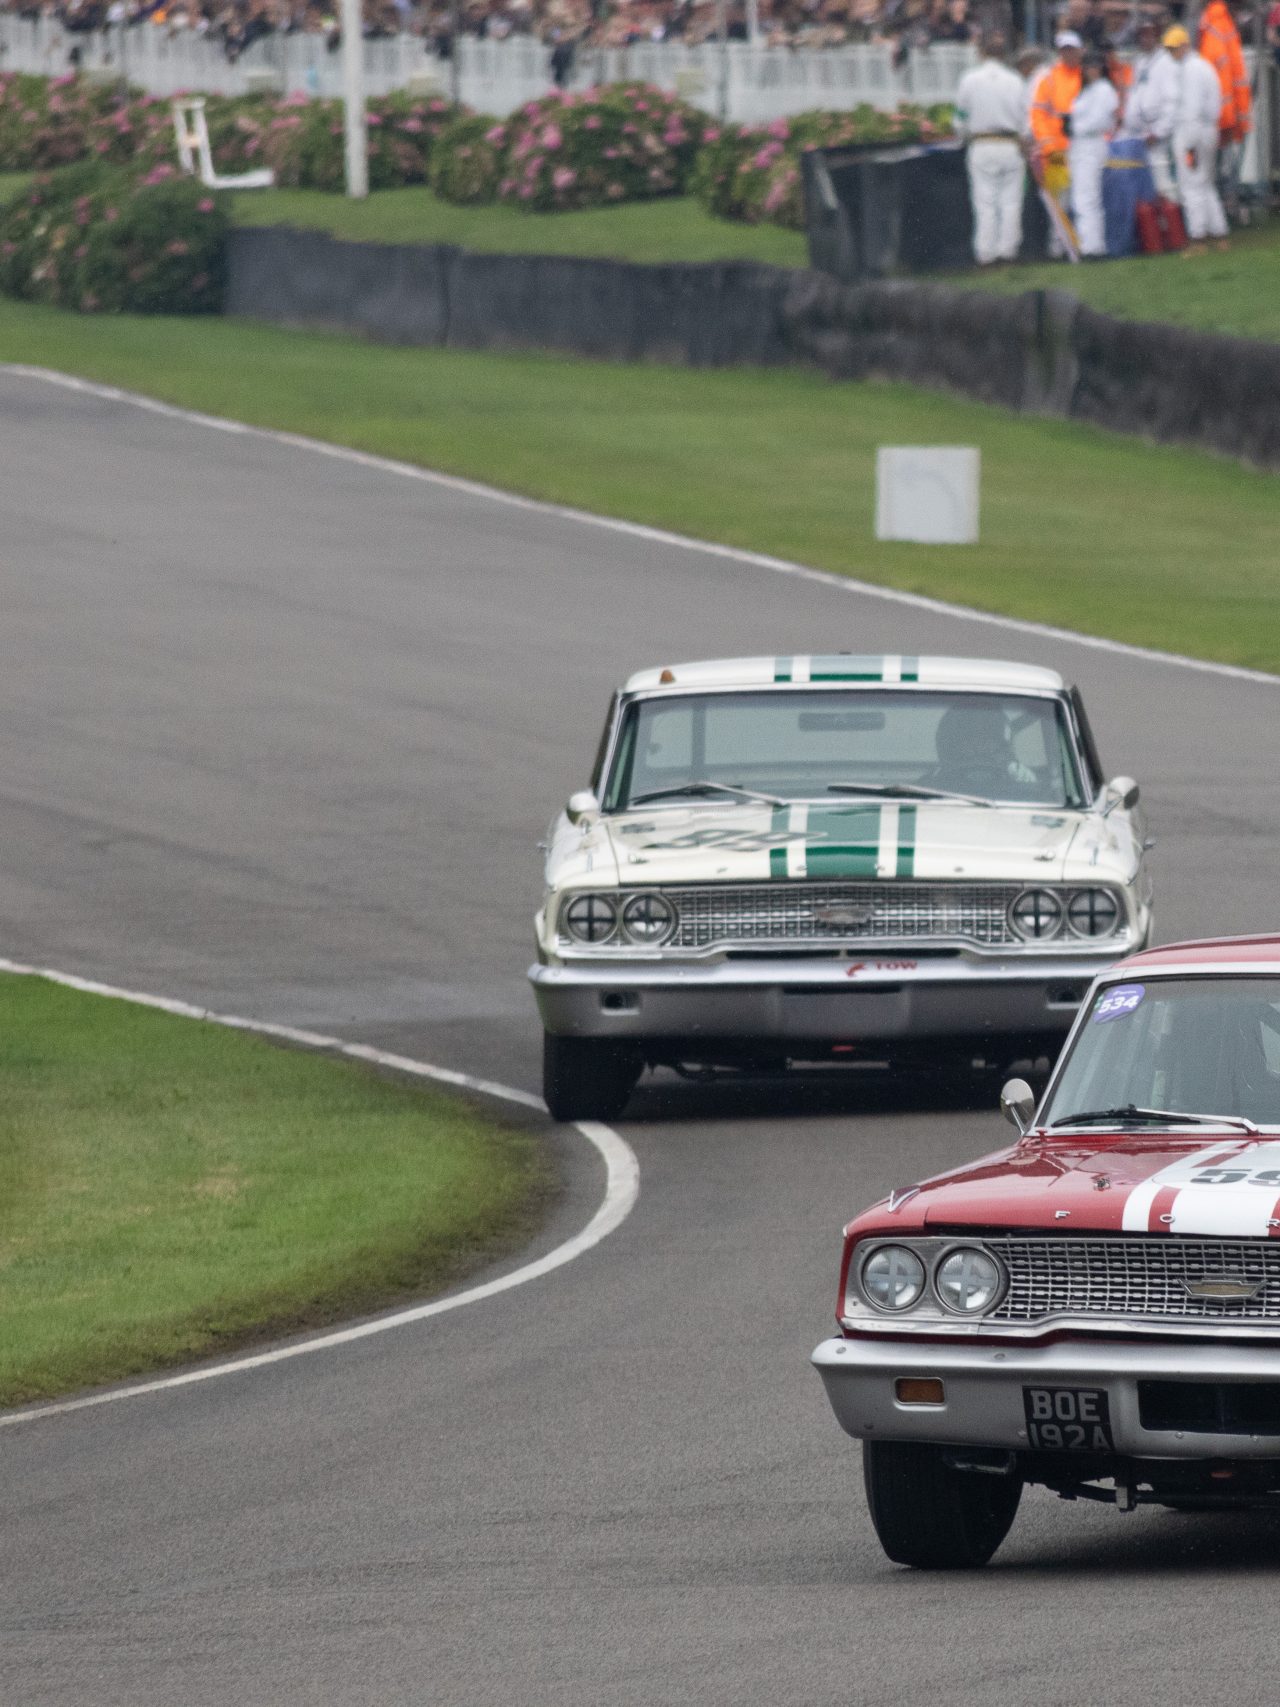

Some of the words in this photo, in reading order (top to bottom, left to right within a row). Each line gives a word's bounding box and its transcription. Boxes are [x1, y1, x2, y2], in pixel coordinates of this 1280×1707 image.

[875, 959, 918, 971] TOW
[1098, 995, 1140, 1014] 534
[1029, 1389, 1102, 1422] BOE
[1029, 1422, 1112, 1451] 192A
